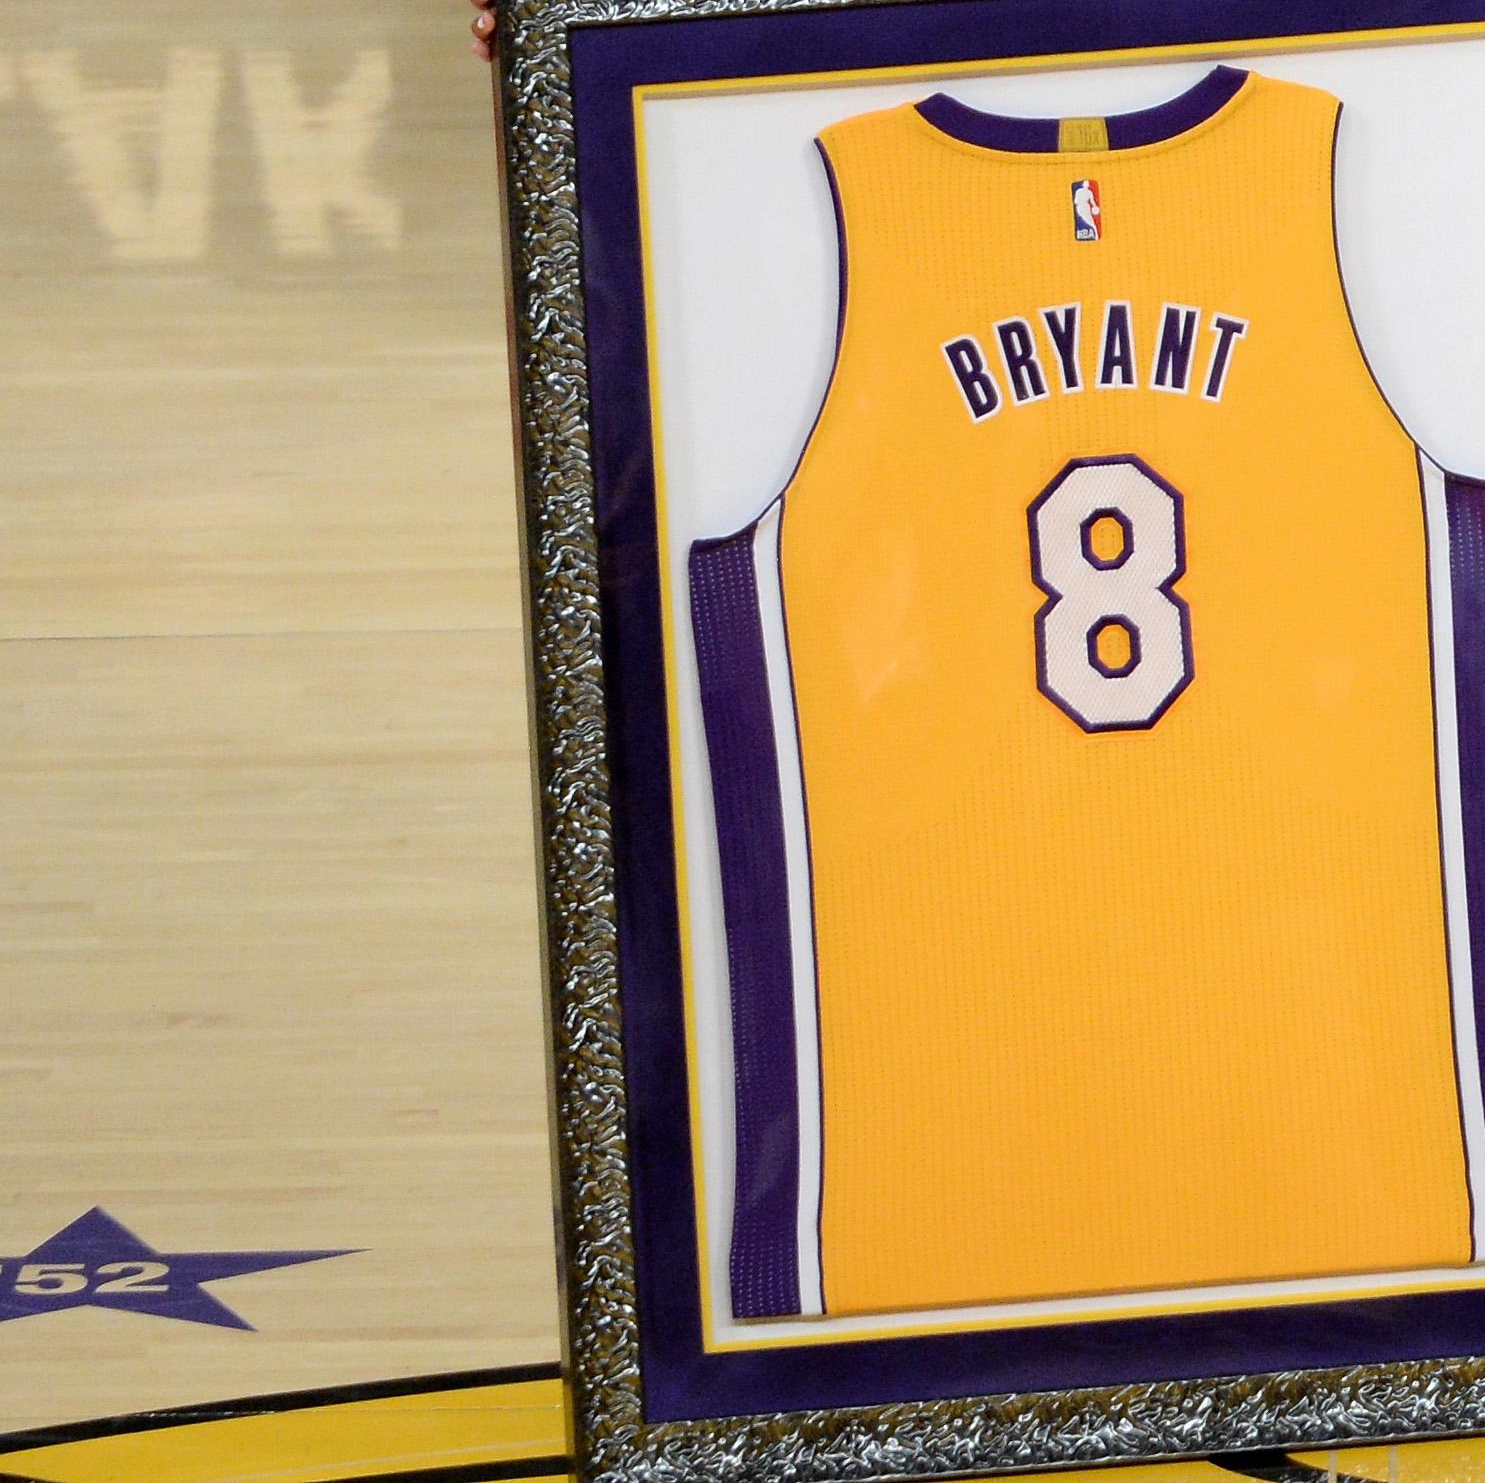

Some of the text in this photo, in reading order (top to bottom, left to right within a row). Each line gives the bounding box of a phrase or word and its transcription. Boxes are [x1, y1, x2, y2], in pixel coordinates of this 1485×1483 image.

[940, 299, 1249, 423] BRYANT
[1026, 453, 1195, 734] 8
[0, 1261, 170, 1295] 52
